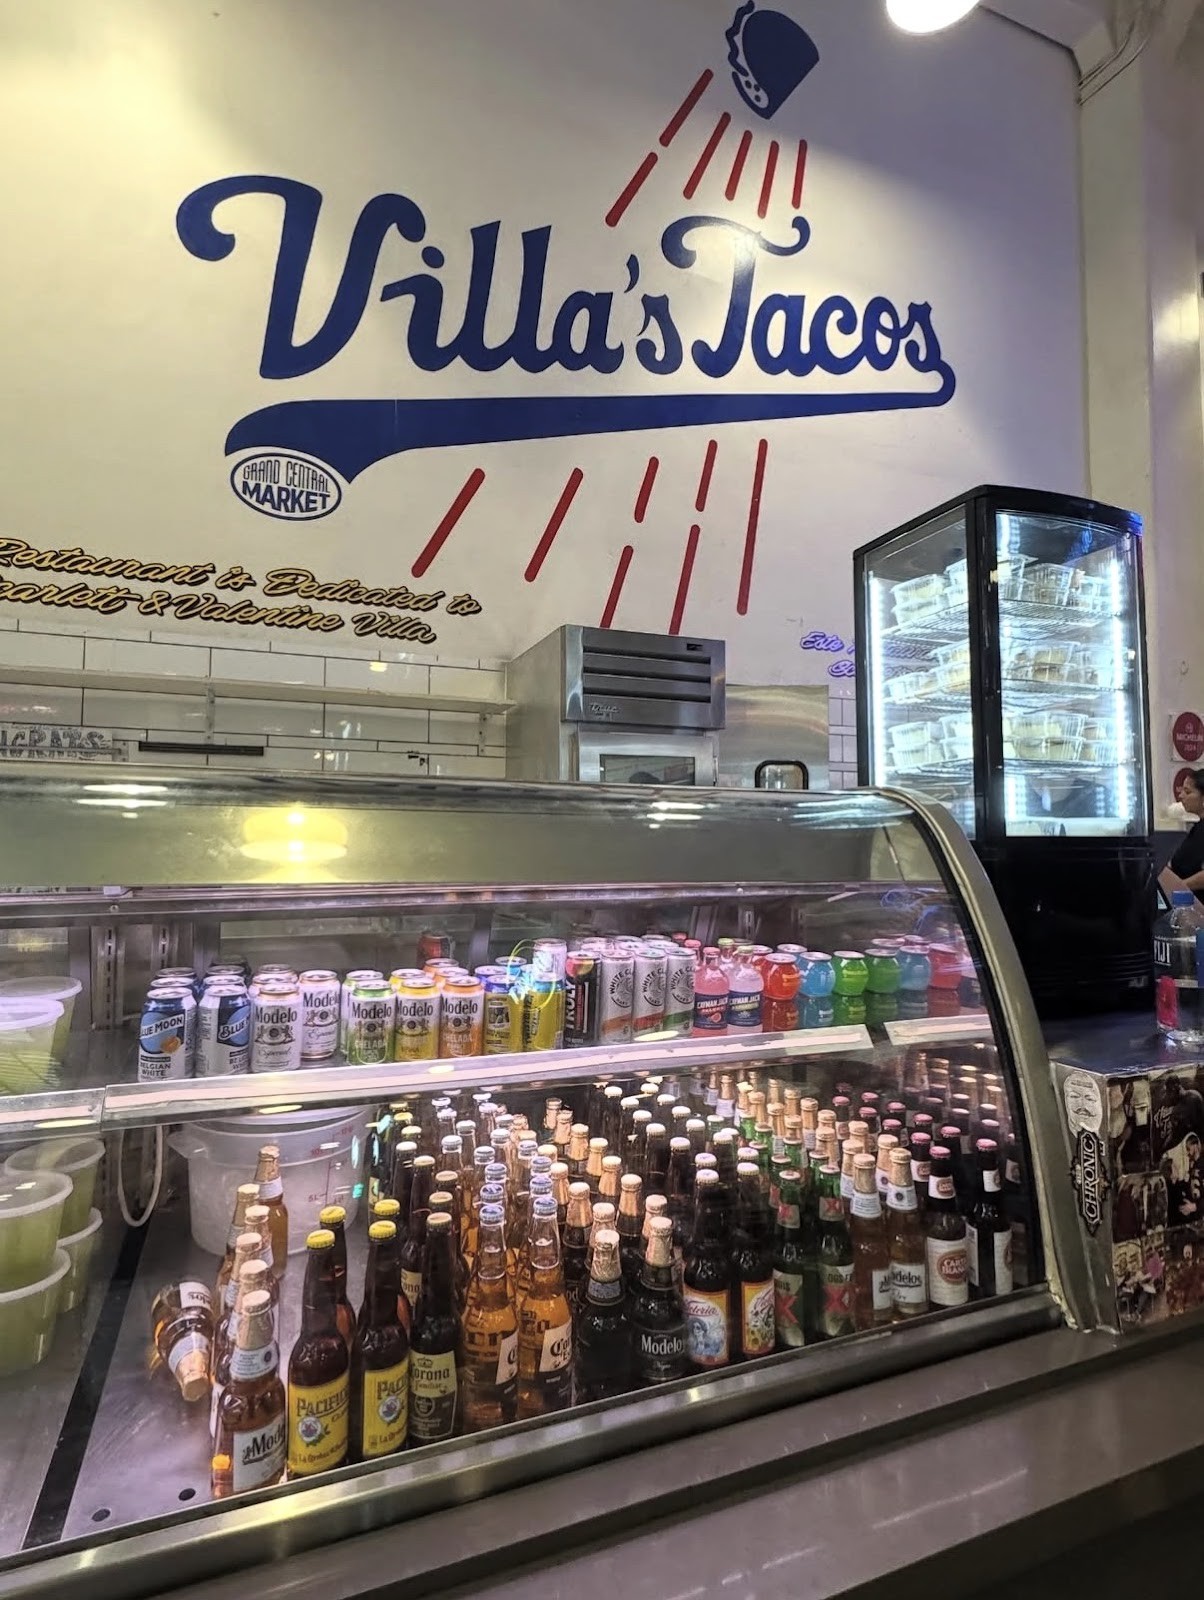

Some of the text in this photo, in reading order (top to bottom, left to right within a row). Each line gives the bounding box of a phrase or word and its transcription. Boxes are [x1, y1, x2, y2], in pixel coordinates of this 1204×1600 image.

[176, 174, 945, 380] Villa's Tacos
[243, 460, 330, 494] GRAND CENTRAL
[242, 480, 331, 513] MARKET
[215, 565, 252, 591] is
[263, 568, 446, 612] Dedicated
[446, 594, 482, 616] to
[0, 577, 437, 644] carlett & Valentine Villa
[800, 631, 844, 652] Este
[609, 971, 624, 994] WHITE
[642, 970, 657, 993] WHITE
[670, 968, 684, 990] WHITE
[255, 1005, 298, 1024] Modelo
[352, 1001, 392, 1020] Modelo
[442, 998, 478, 1014] Modelo
[565, 979, 577, 1029] TRULY
[154, 1016, 183, 1033] MOON
[220, 1020, 245, 1038] BLUE
[141, 1068, 167, 1077] WHITE
[1083, 1137, 1097, 1218] CHRONIC
[641, 1334, 683, 1356] Modelo
